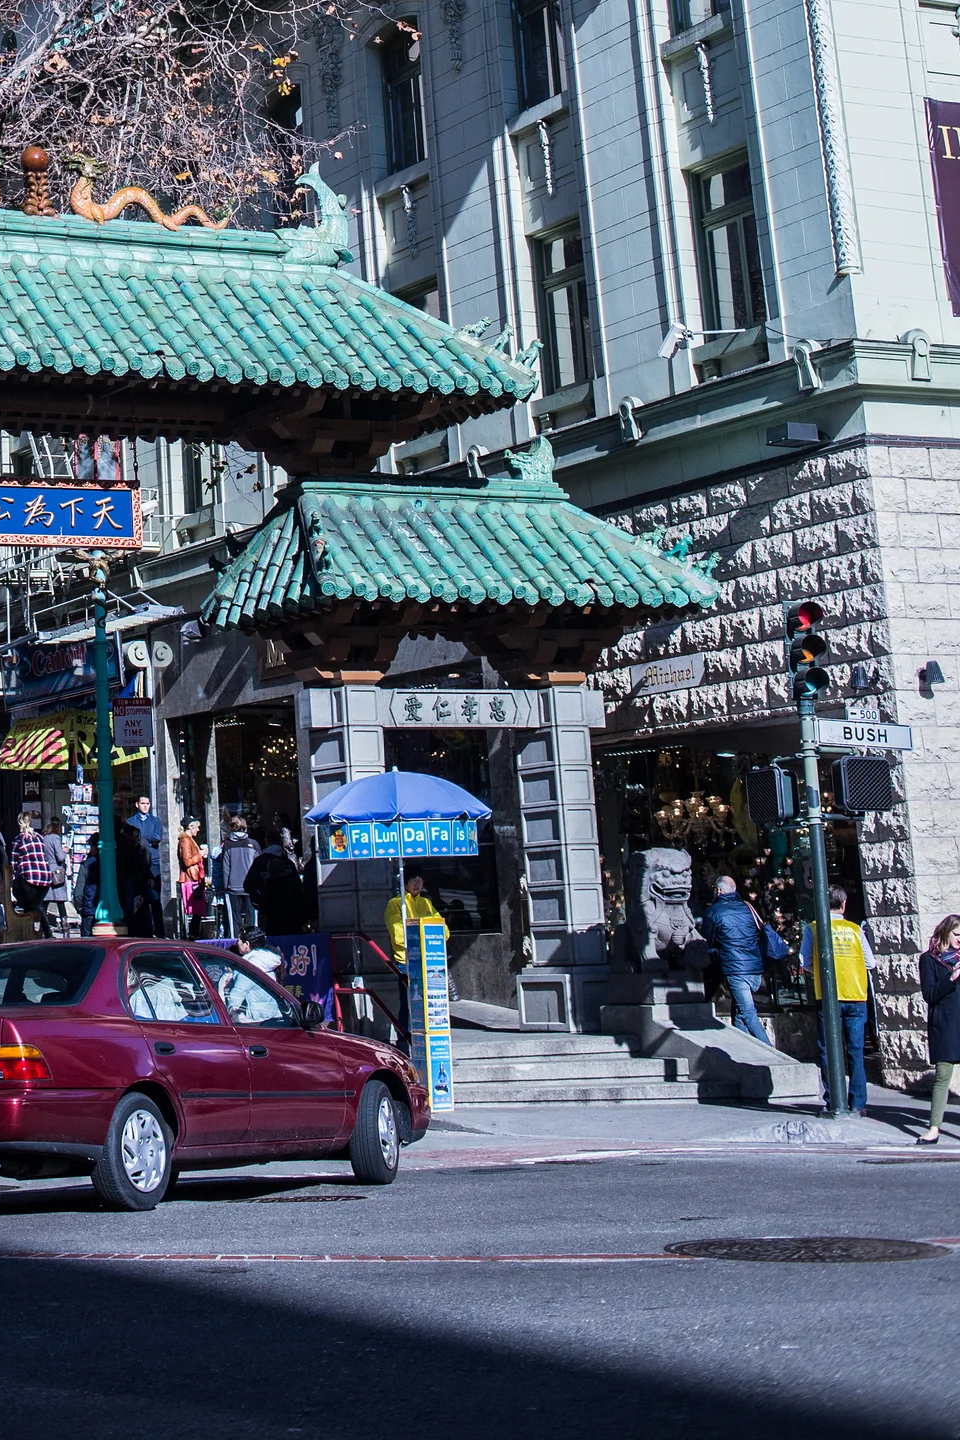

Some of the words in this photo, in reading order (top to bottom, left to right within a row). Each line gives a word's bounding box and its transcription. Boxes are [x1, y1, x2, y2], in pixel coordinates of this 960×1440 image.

[642, 660, 695, 689] Michael
[113, 706, 125, 715] NO
[126, 707, 150, 715] STOPPING
[860, 710, 877, 719] 500
[124, 720, 141, 728] ANY
[123, 729, 143, 737] TIME
[843, 726, 888, 743] BUSH
[352, 829, 369, 844] Fa
[375, 829, 397, 843] Lun
[404, 827, 424, 842] Da
[432, 826, 448, 841] Fa
[456, 827, 465, 841] is
